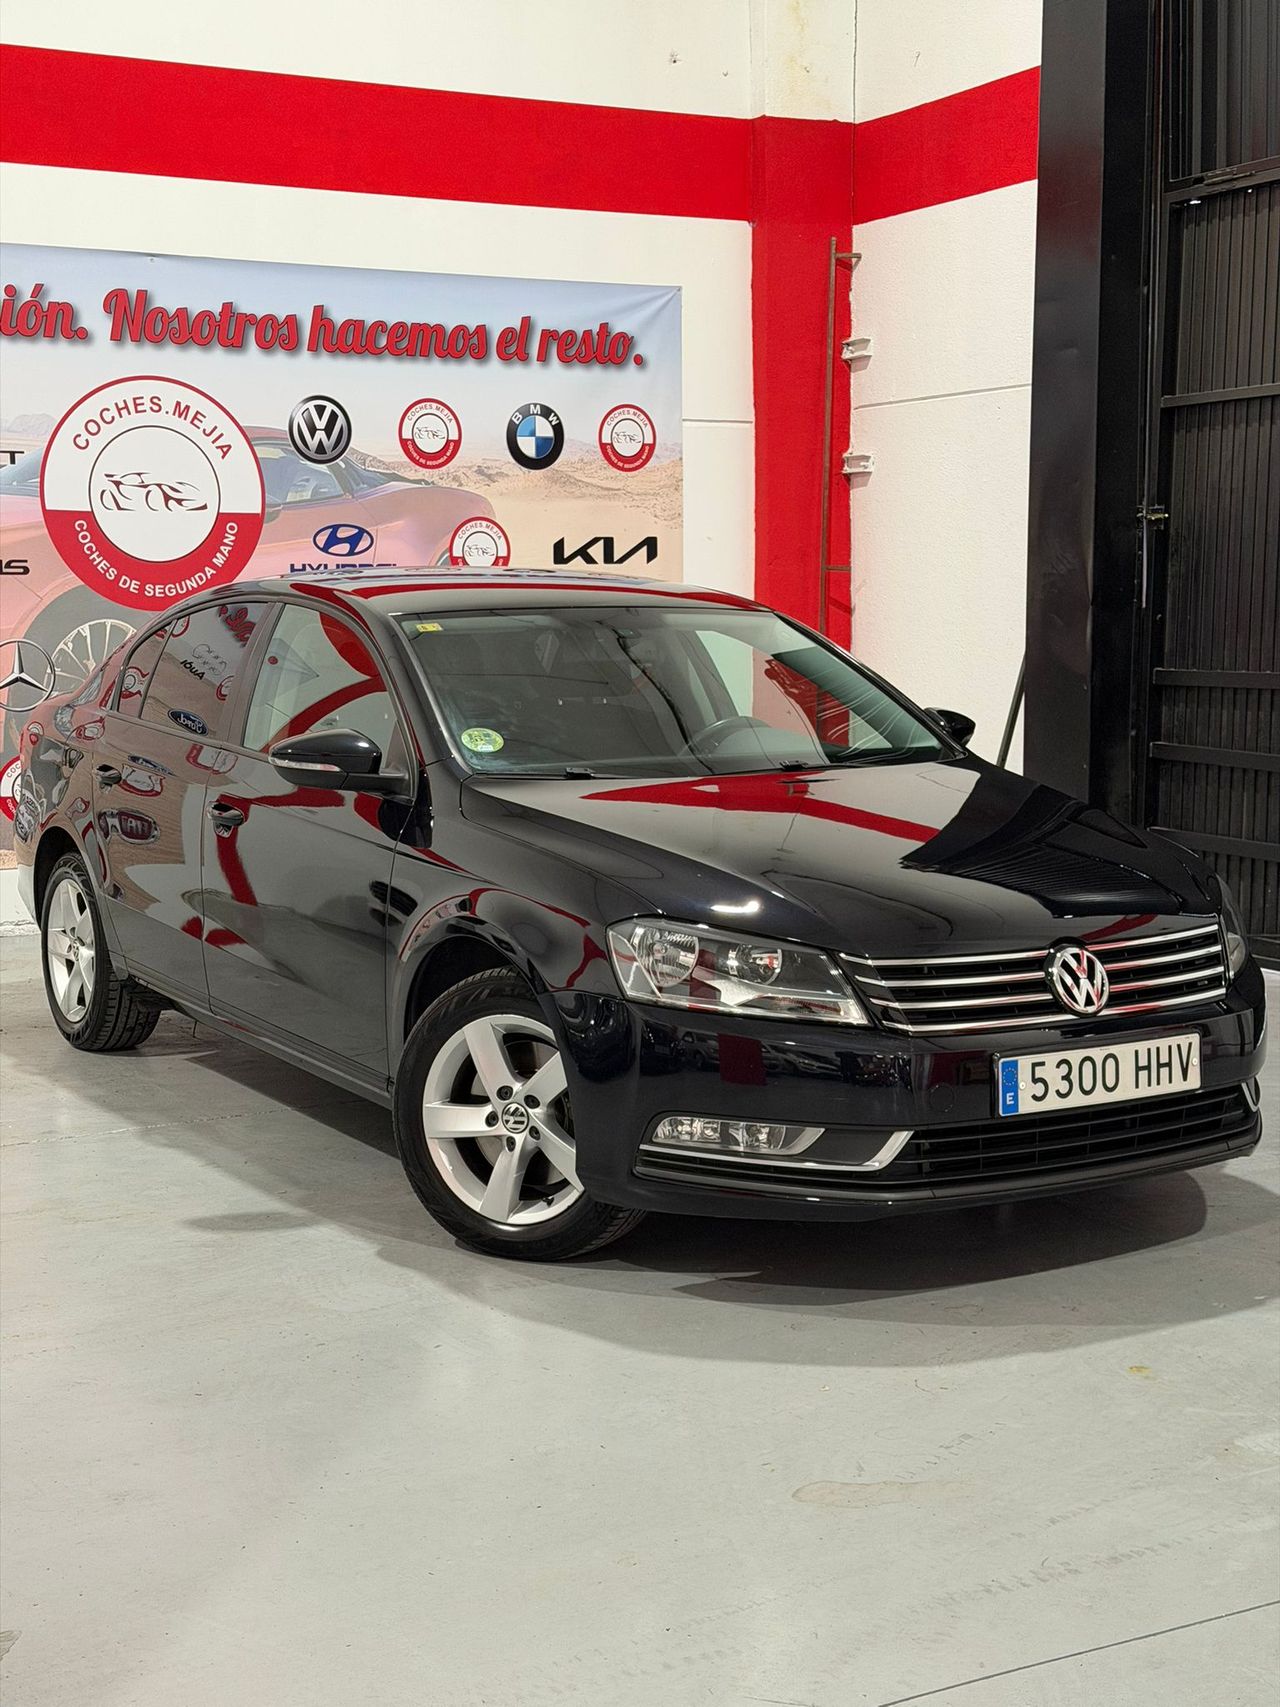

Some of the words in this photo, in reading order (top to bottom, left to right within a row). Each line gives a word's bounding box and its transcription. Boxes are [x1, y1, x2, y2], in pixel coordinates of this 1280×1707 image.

[103, 288, 298, 351] Nosotros
[307, 305, 487, 360] hacemos
[496, 316, 531, 361] el
[536, 322, 643, 366] resto.
[511, 404, 560, 426] BMW
[75, 520, 117, 580] COCHES
[119, 576, 141, 594] DE
[144, 566, 216, 597] SEGUNDA
[212, 522, 238, 567] MANO
[553, 536, 657, 565] KIA
[1030, 1052, 1120, 1102] 5300
[1134, 1041, 1193, 1090] HHV
[1006, 1092, 1015, 1105] E
